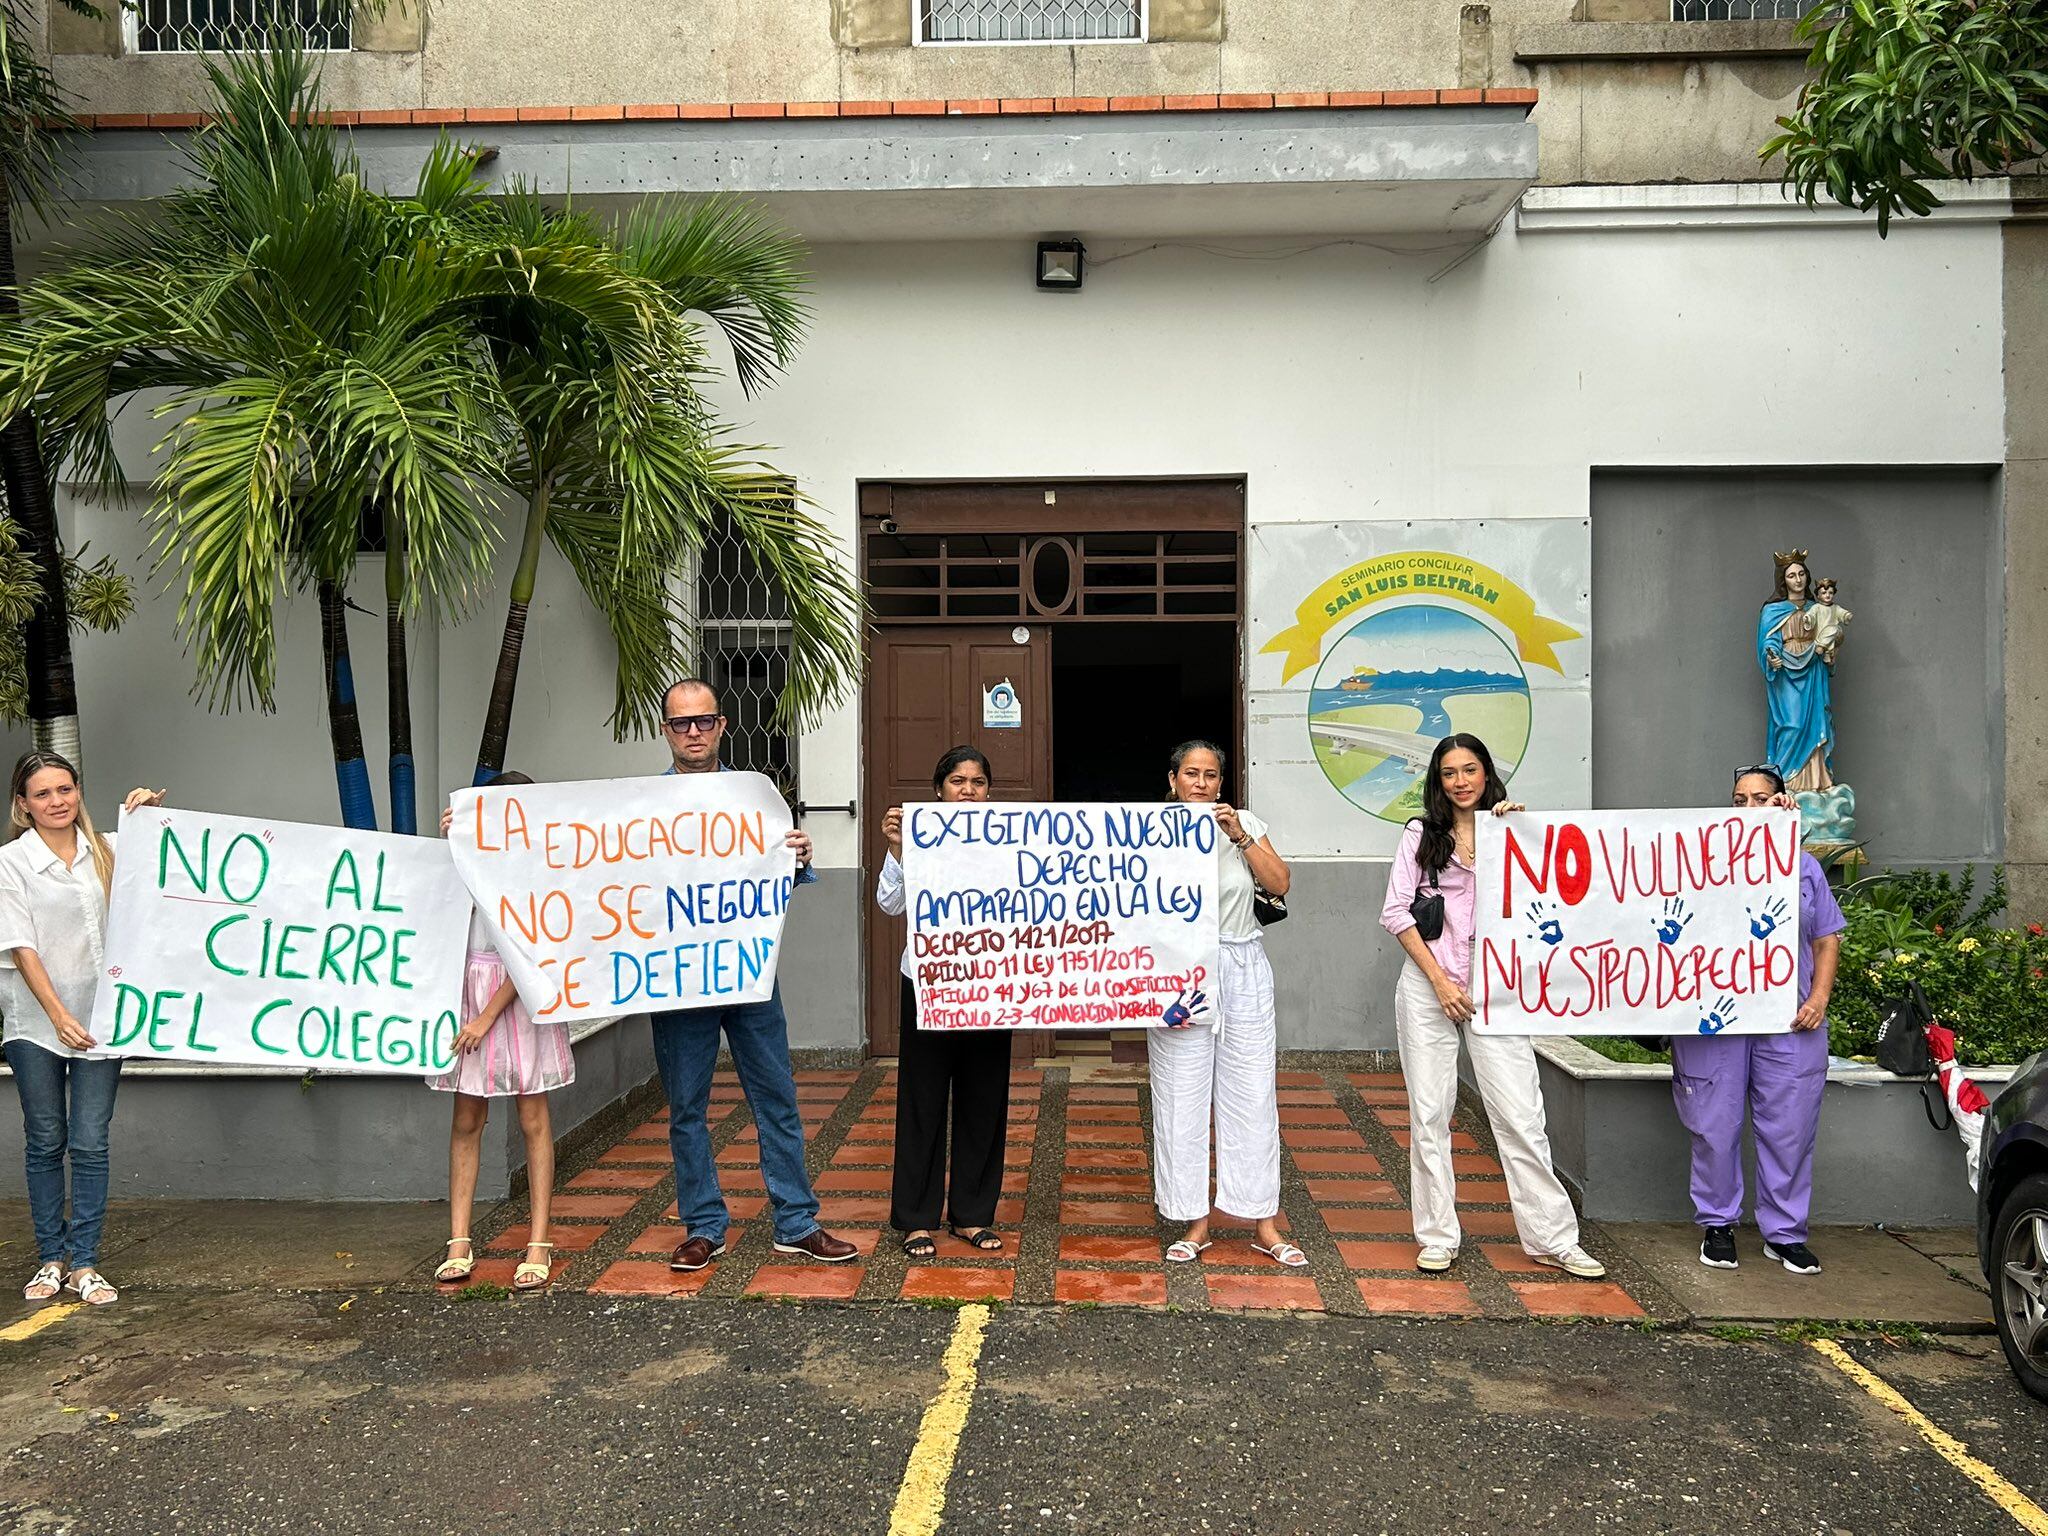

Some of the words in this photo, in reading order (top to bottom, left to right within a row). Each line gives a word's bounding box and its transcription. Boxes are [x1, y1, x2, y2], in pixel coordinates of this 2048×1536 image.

[1325, 586, 1362, 617] SAN
[1365, 574, 1408, 597] LUIS
[1413, 573, 1500, 604] BELTRÁN
[1341, 559, 1405, 588] SEMINARIO
[1408, 558, 1474, 576] CONCILIAR
[475, 795, 531, 851] LA
[545, 811, 765, 869] EDUCACION
[911, 807, 1094, 850] EXIGIMOS
[1104, 805, 1216, 854] NUESTRO
[326, 849, 403, 913] AL
[1017, 850, 1148, 888] DERECHO
[1502, 823, 1592, 918] NO
[1598, 817, 1797, 903] VULNEREN
[500, 890, 575, 944] NO
[591, 885, 656, 941] SE
[916, 888, 1066, 932] AMPARADO
[1076, 888, 1110, 921] EN
[1116, 882, 1149, 919] LA
[1157, 876, 1202, 922] LEY
[205, 914, 417, 989] CIERRE
[914, 928, 1005, 959] DECRETO
[1008, 919, 1115, 949] 1421/2017
[918, 954, 997, 987] ARTICULO
[998, 952, 1018, 977] 11
[1024, 951, 1055, 976] LEY
[1057, 946, 1155, 976] 1751/2015
[1483, 937, 1649, 1025] NUESTRO
[1656, 939, 1794, 1009] DERECHO
[920, 978, 989, 1010] ARTICULO
[994, 979, 1015, 1002] 44
[1059, 981, 1078, 998] DE
[1084, 977, 1100, 996] LA
[923, 1008, 991, 1029] ARTICULO
[106, 983, 218, 1051] DEL
[251, 999, 458, 1068] COLEGIO
